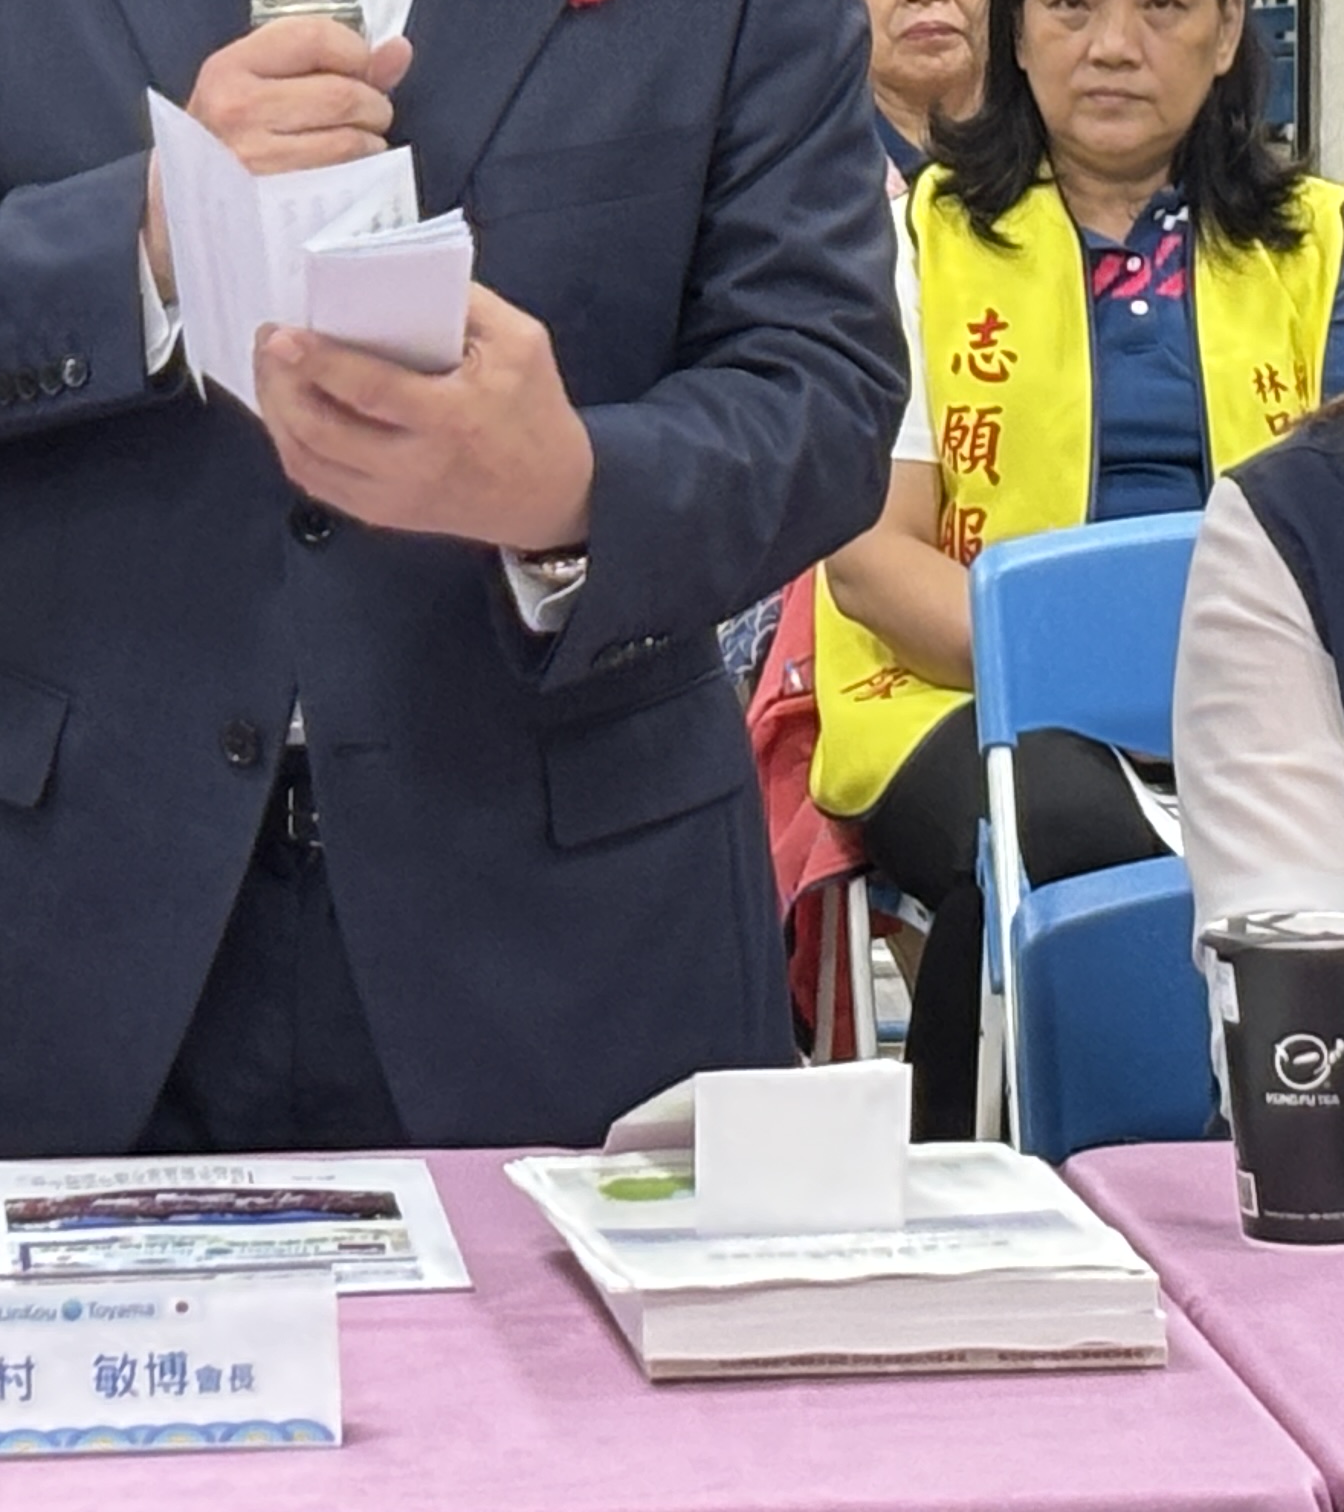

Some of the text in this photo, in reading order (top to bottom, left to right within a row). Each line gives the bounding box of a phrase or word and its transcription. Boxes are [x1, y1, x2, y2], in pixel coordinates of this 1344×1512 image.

[87, 1301, 155, 1320] Toyama
[92, 1351, 256, 1399] 敏博會長
